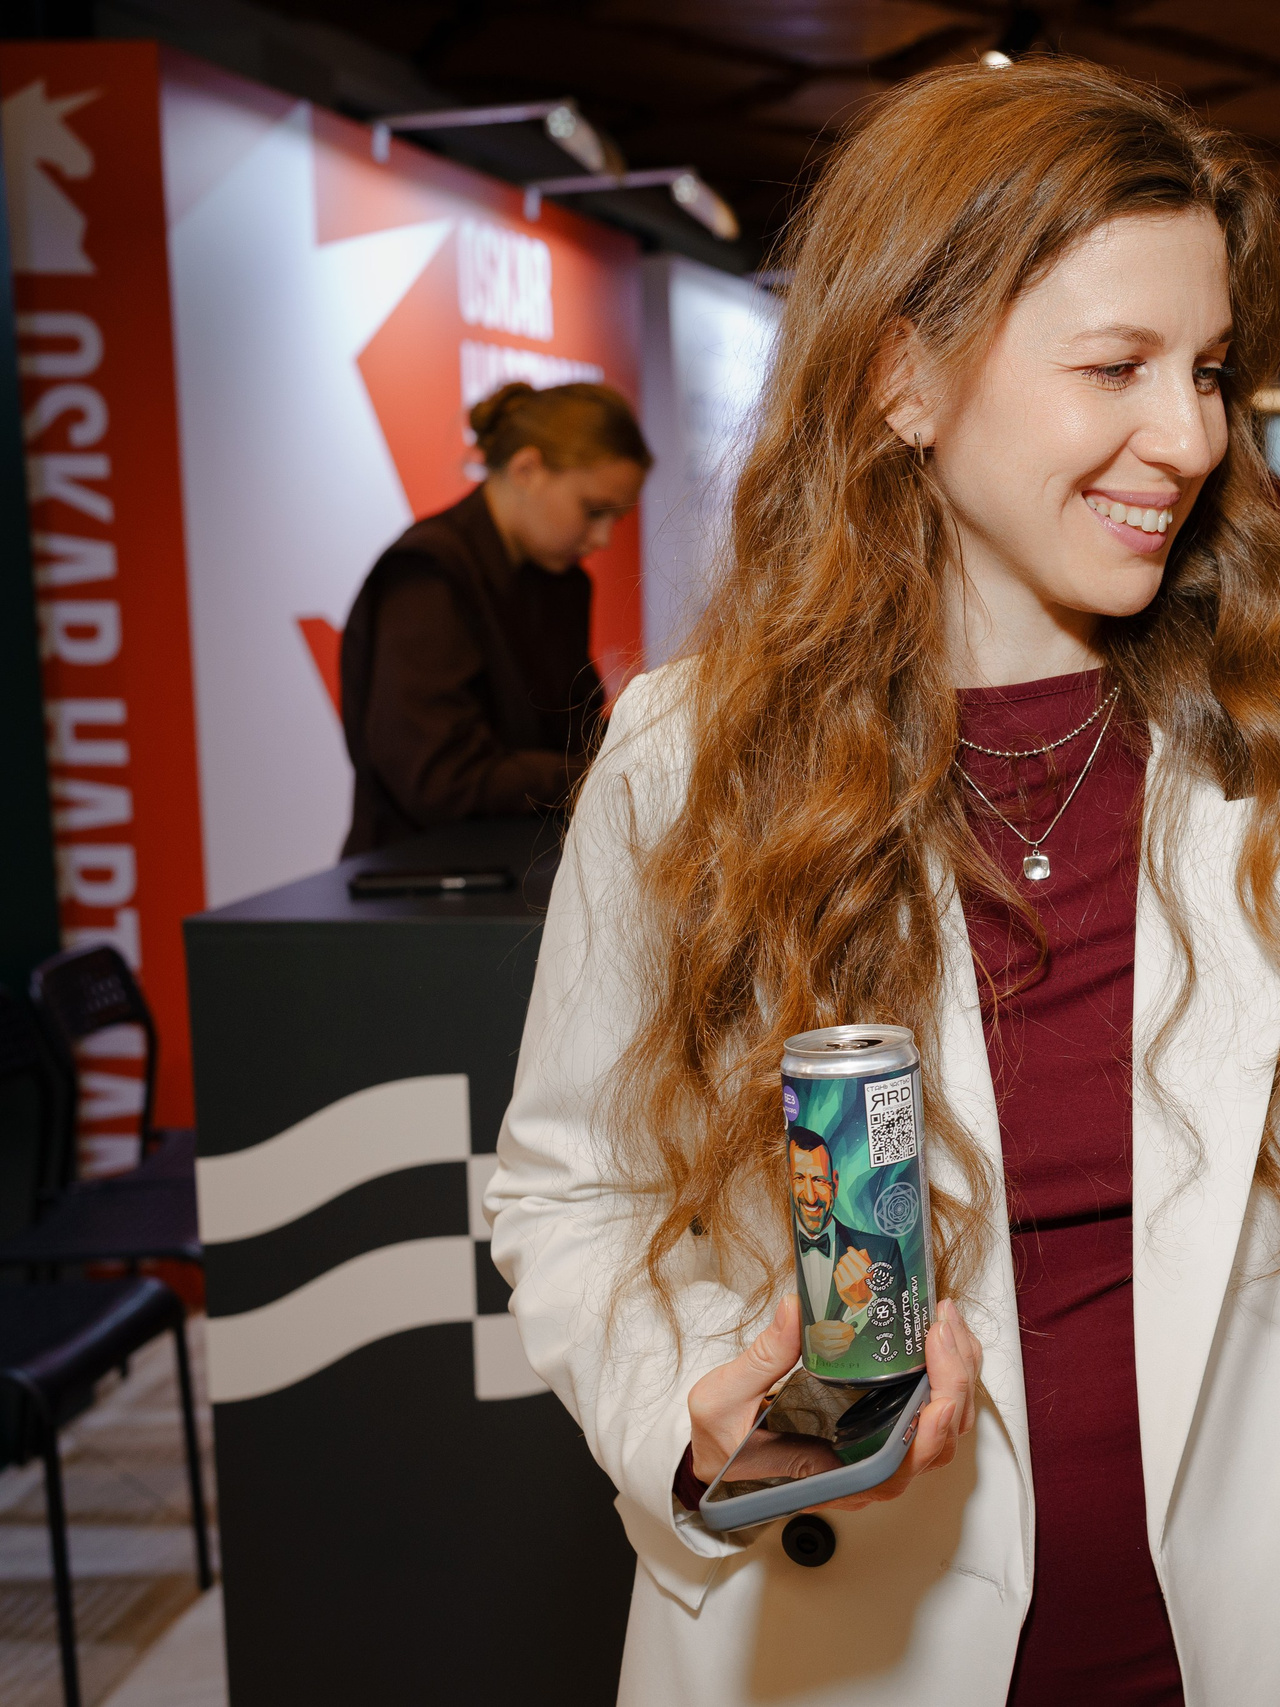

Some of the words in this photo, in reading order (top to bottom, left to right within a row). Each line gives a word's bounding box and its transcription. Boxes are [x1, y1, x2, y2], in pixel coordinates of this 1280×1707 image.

[20, 310, 123, 667] OSKAR
[901, 1289, 912, 1336] ФРУКТОВ
[910, 1275, 922, 1342] ПРЕБИОТИКИ
[905, 1337, 914, 1355] СОК
[915, 1343, 923, 1353] И
